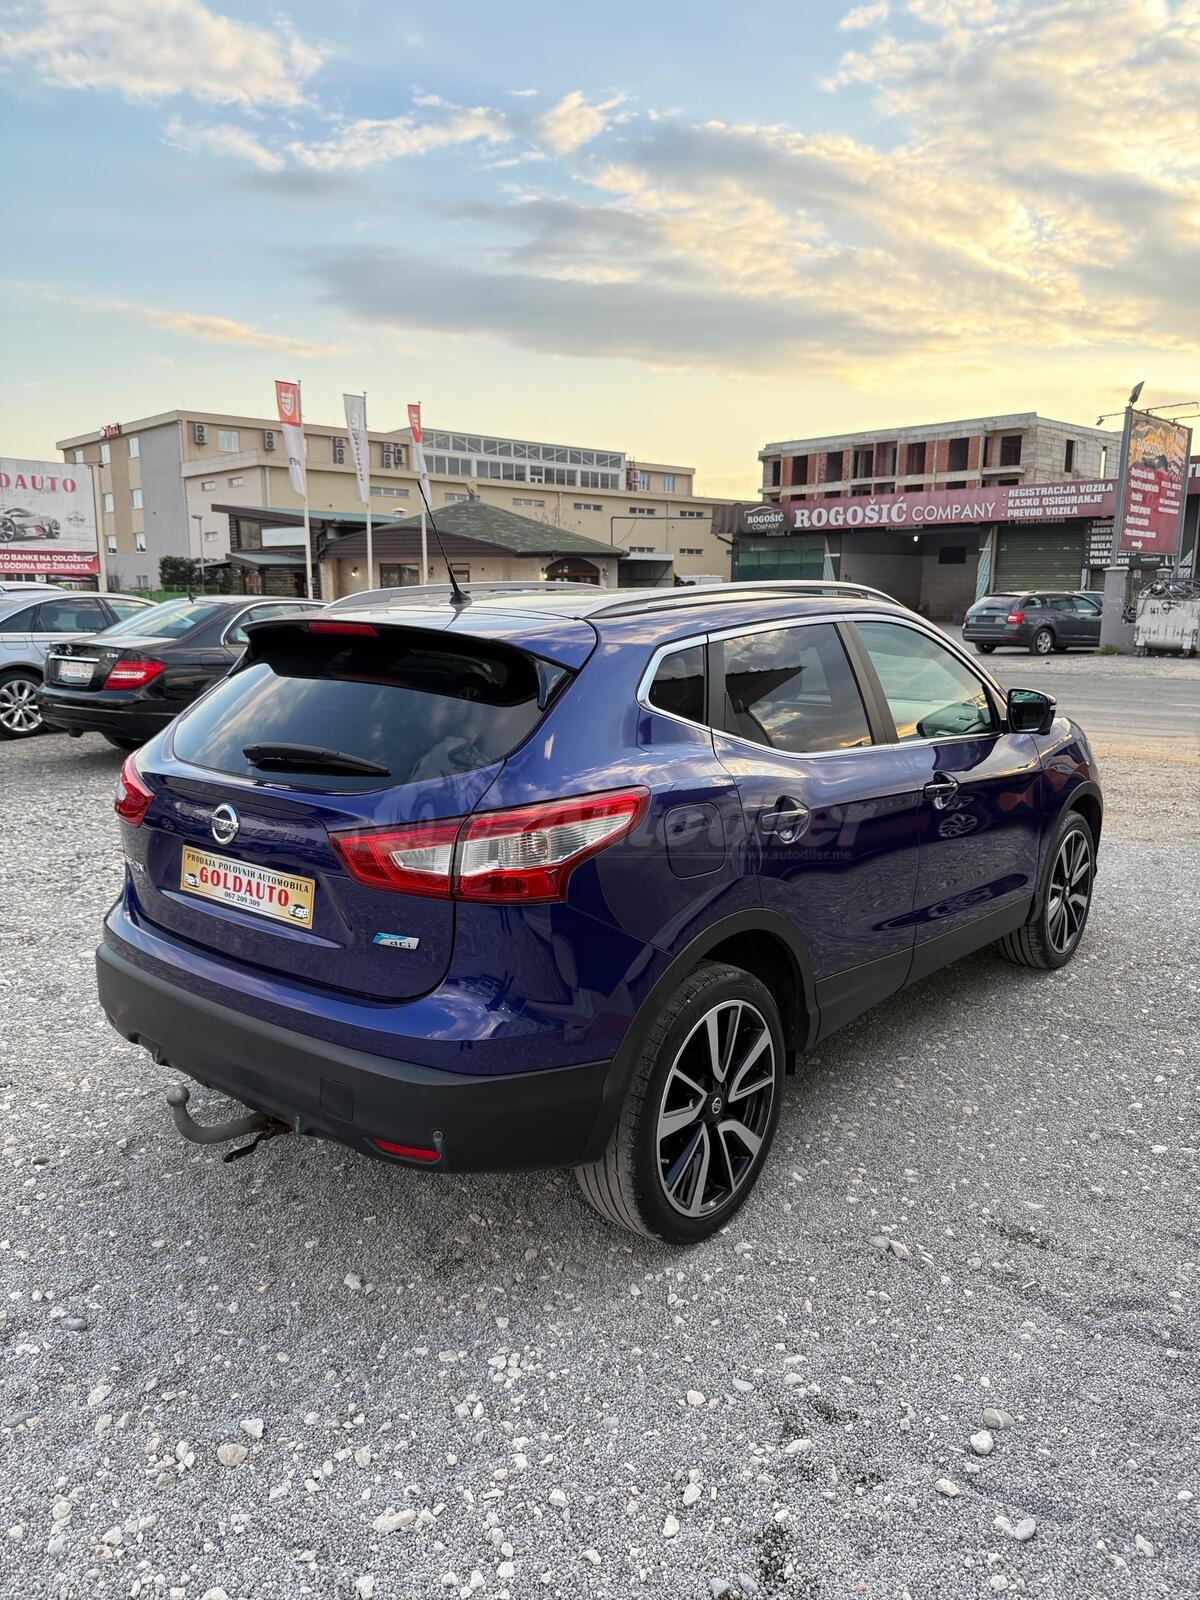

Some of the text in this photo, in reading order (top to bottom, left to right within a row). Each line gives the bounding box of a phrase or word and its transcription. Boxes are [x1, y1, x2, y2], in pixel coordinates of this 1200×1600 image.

[1008, 483, 1114, 498] REGISTRACIJA VOZILA
[1007, 494, 1103, 508] KASKO OSIGURANJE
[747, 512, 784, 524] ROGOŠIĆ
[794, 496, 997, 528] ROGOŠIĆ COMPANY
[1006, 505, 1078, 518] PREVOD VOZILA
[751, 523, 779, 531] COMPANY
[4, 562, 36, 570] GODINA
[52, 562, 90, 570] ŽIRANATA
[187, 852, 310, 894] PRODAJA POLOVNIH AUTOMOBILA
[199, 866, 290, 907] GOLDAUTO
[224, 891, 236, 899] 067
